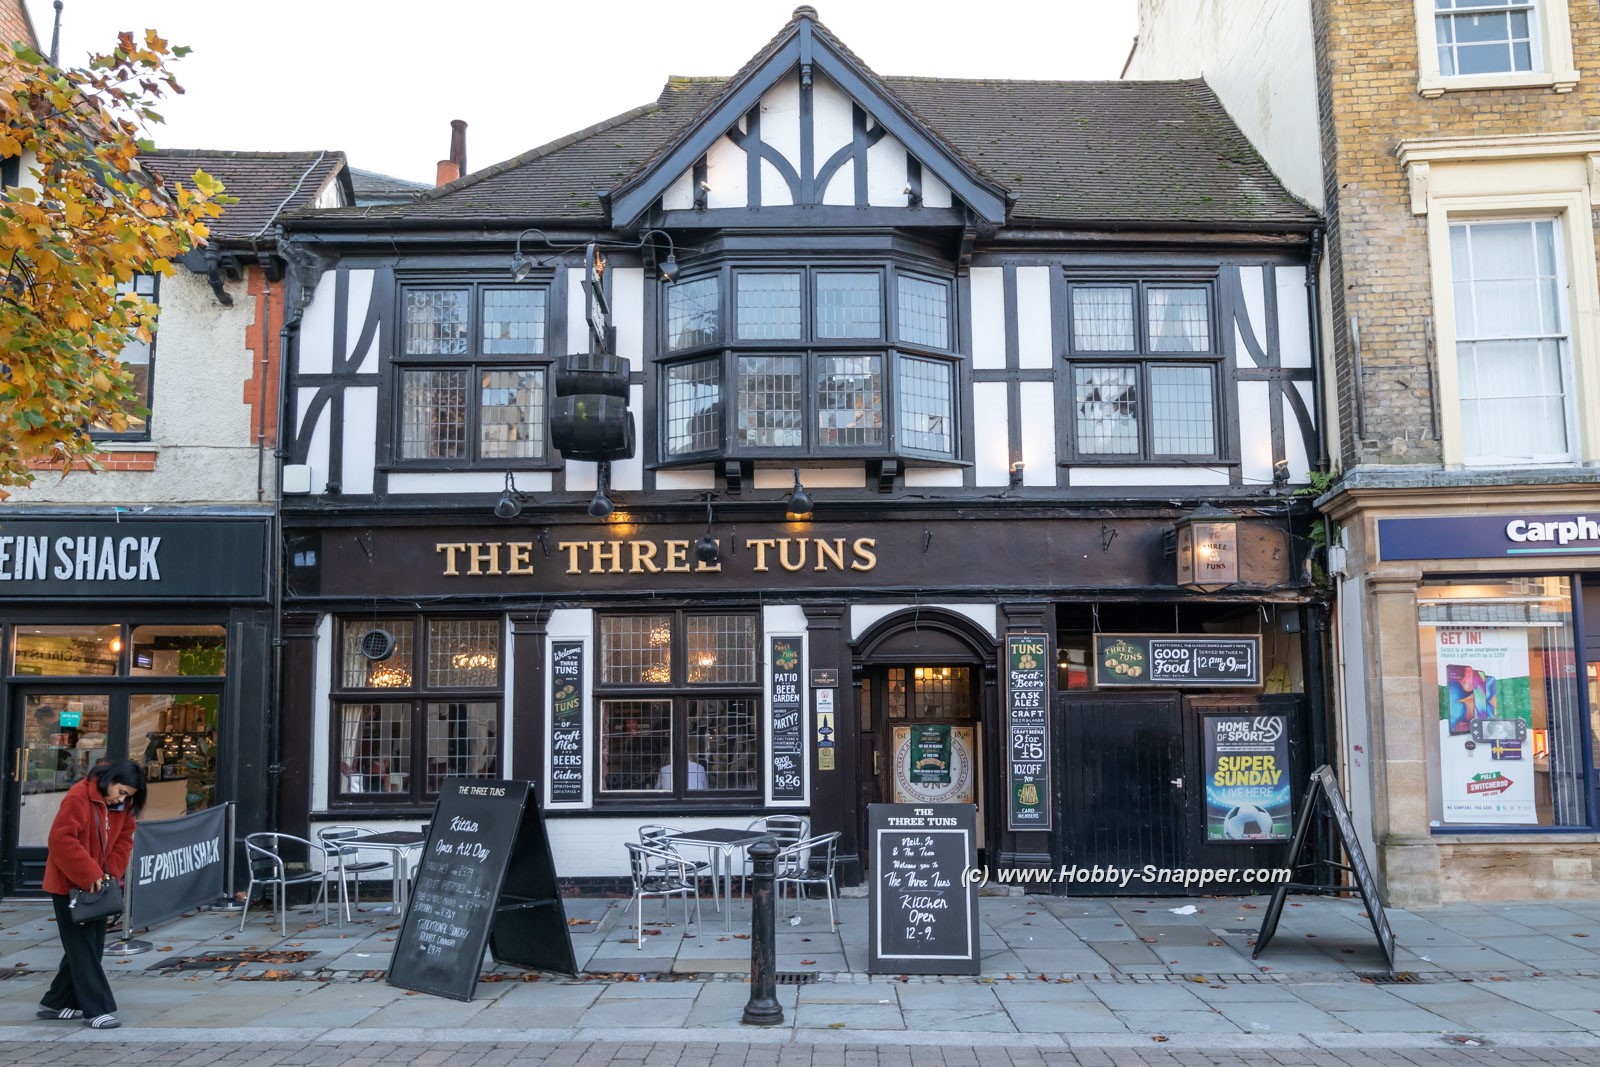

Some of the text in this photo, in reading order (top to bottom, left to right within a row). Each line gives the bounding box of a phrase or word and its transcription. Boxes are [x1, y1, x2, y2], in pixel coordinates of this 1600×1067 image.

[1506, 516, 1600, 544] Carph
[54, 536, 161, 580] SHACK
[436, 537, 877, 576] THE THREE TUNS
[1441, 632, 1482, 644] GET IN!
[554, 647, 582, 661] Welcome
[1011, 644, 1044, 655] TUNS
[1105, 646, 1134, 655] THREE
[1154, 649, 1189, 659] GOOD
[1120, 653, 1143, 661] TUNS
[555, 666, 579, 675] TUNS
[1154, 659, 1190, 675] Food
[774, 673, 798, 682] PATIO
[1011, 671, 1039, 680] Great
[776, 684, 796, 694] BEER
[1015, 679, 1044, 688] Beers
[773, 693, 800, 703] GARDEN
[1014, 692, 1040, 700] CASK
[555, 698, 580, 713] TUNS
[1015, 699, 1039, 707] ALES
[1011, 710, 1045, 718] CRAFT
[773, 712, 798, 730] PARTY?
[1217, 722, 1249, 732] HOME
[554, 730, 581, 743] Craft
[1014, 734, 1040, 749] 2 for
[1217, 731, 1264, 741] OF SPORT
[554, 740, 579, 750] Ales
[1020, 743, 1043, 759] £5
[553, 755, 582, 765] BEERS
[775, 755, 790, 765] GOOD
[1218, 755, 1275, 772] SUPER
[553, 770, 582, 780] Ciders
[774, 774, 800, 787] 1826
[1214, 770, 1282, 786] SUNDAY
[459, 786, 505, 797] THE THREE TUNS
[1222, 787, 1274, 798] LIVE HERE
[888, 817, 957, 826] THREE TUNS
[435, 838, 490, 863] Open All Day
[903, 847, 915, 856] The
[919, 847, 935, 856] Team
[152, 844, 195, 881] PROTEIN
[193, 836, 220, 870] SHACK
[884, 871, 951, 887] The Three Tuns
[909, 909, 936, 926] Open
